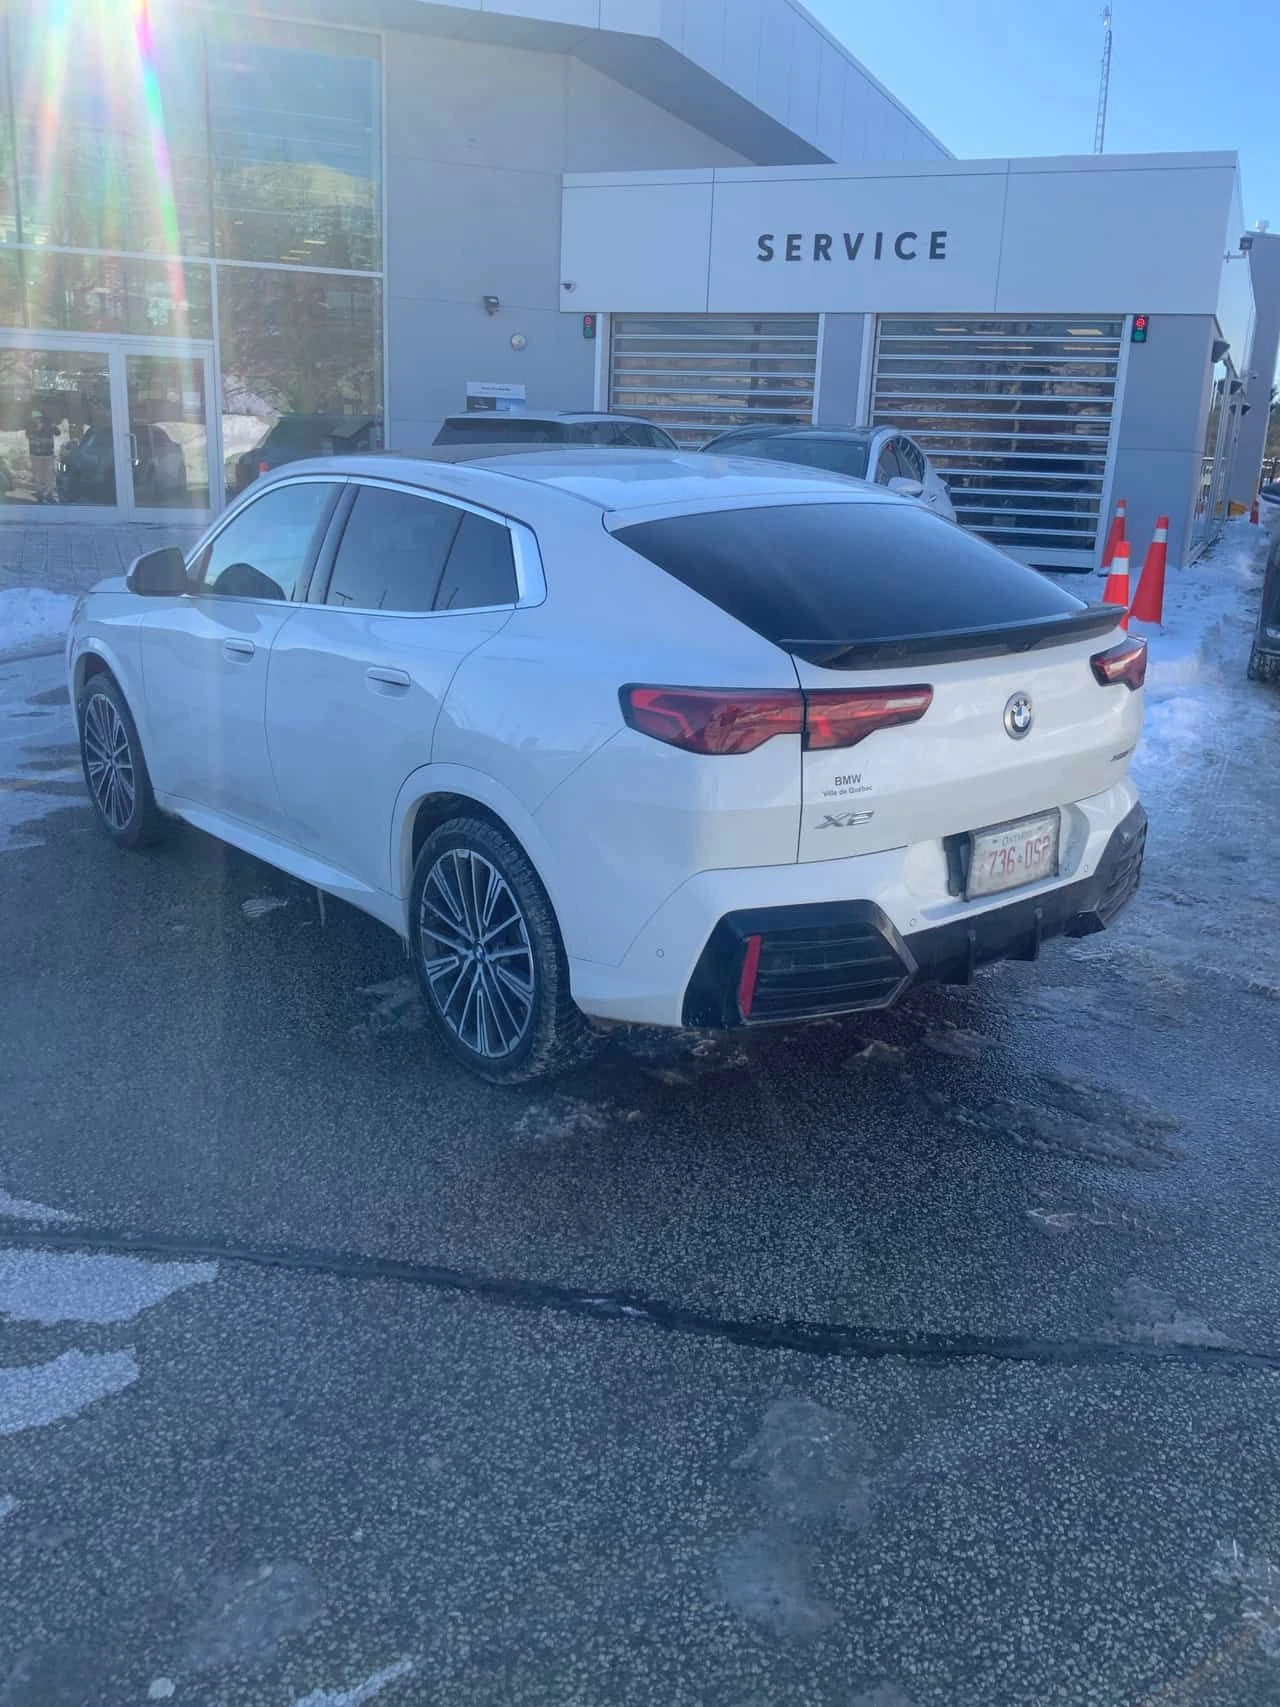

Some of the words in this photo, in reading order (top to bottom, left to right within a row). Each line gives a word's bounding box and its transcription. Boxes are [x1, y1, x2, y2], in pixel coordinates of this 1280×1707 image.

[757, 231, 948, 262] SERVICE
[834, 774, 862, 786] BMW
[814, 810, 874, 829] X2
[989, 846, 1016, 876] 736
